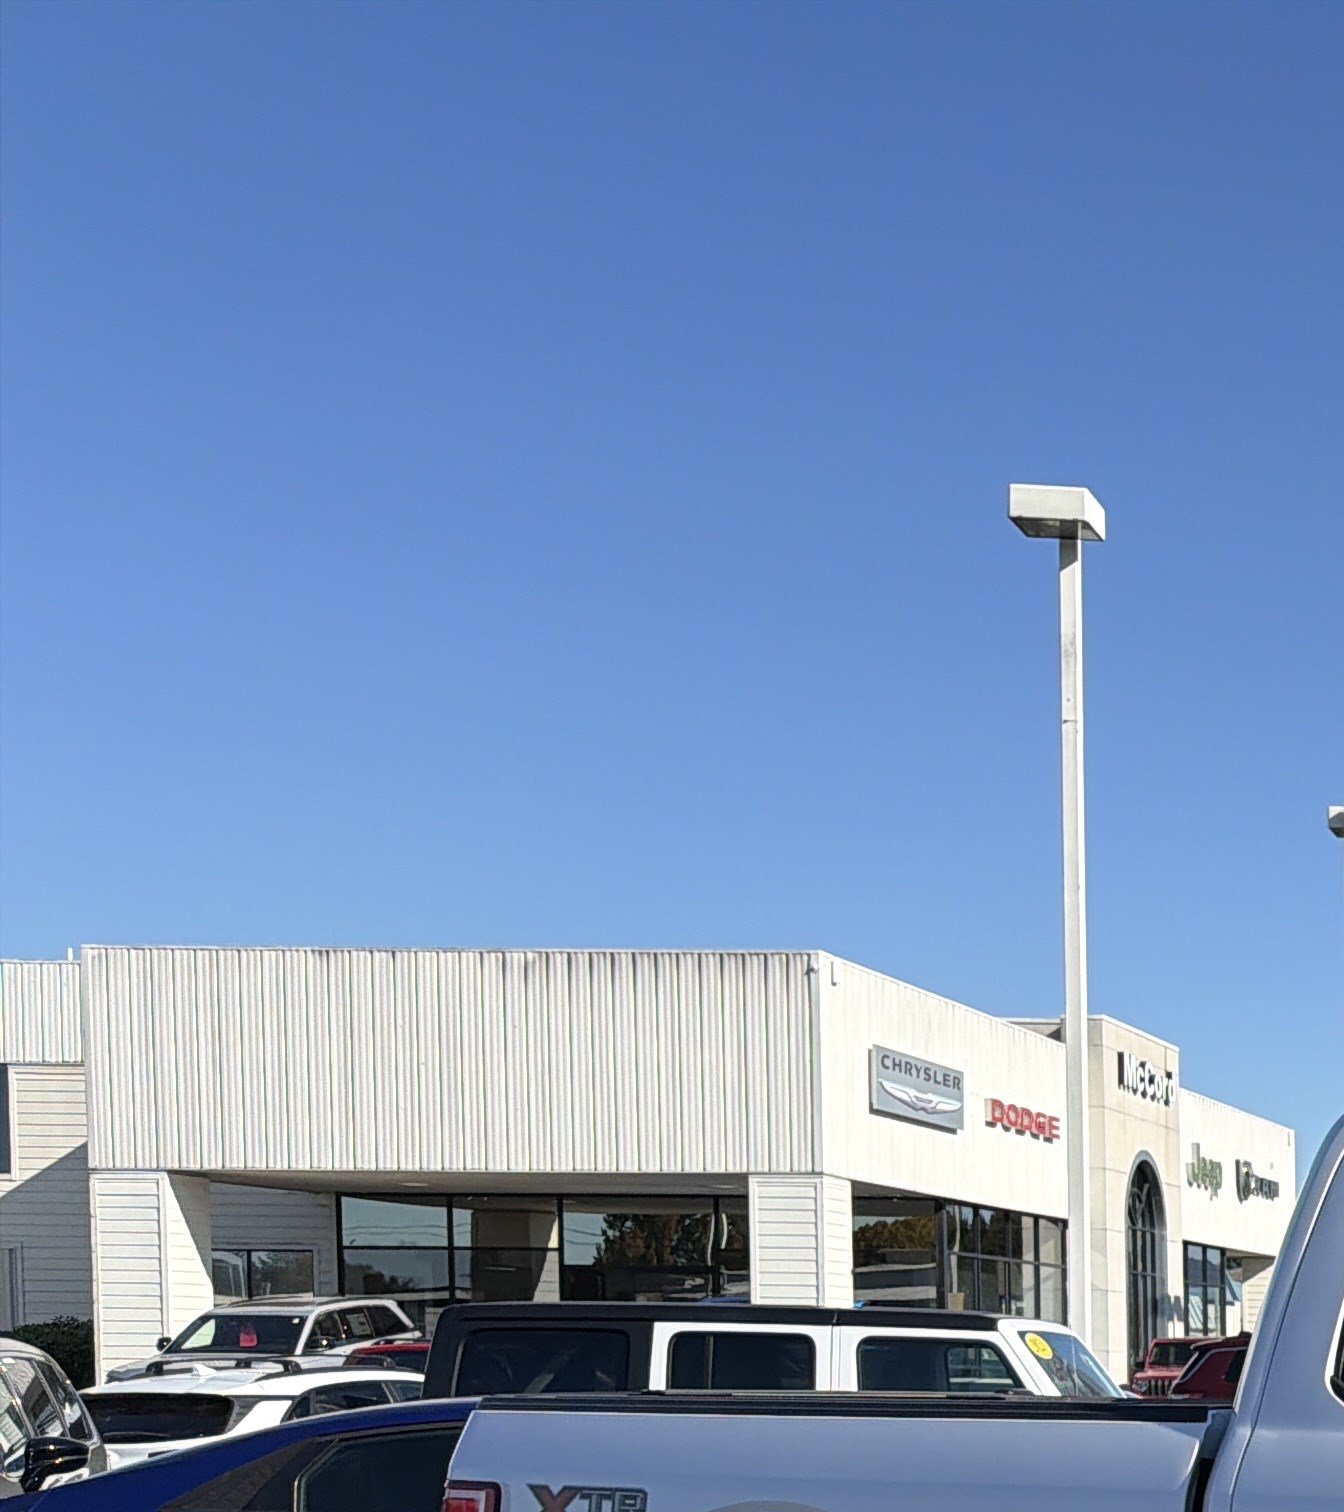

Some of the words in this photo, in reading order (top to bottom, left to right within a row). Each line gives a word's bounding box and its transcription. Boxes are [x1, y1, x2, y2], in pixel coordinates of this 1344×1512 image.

[880, 1053, 962, 1091] CHRYSLER
[1122, 1051, 1178, 1106] McCord
[985, 1097, 1061, 1143] DODGE
[1186, 1142, 1223, 1201] Jeep
